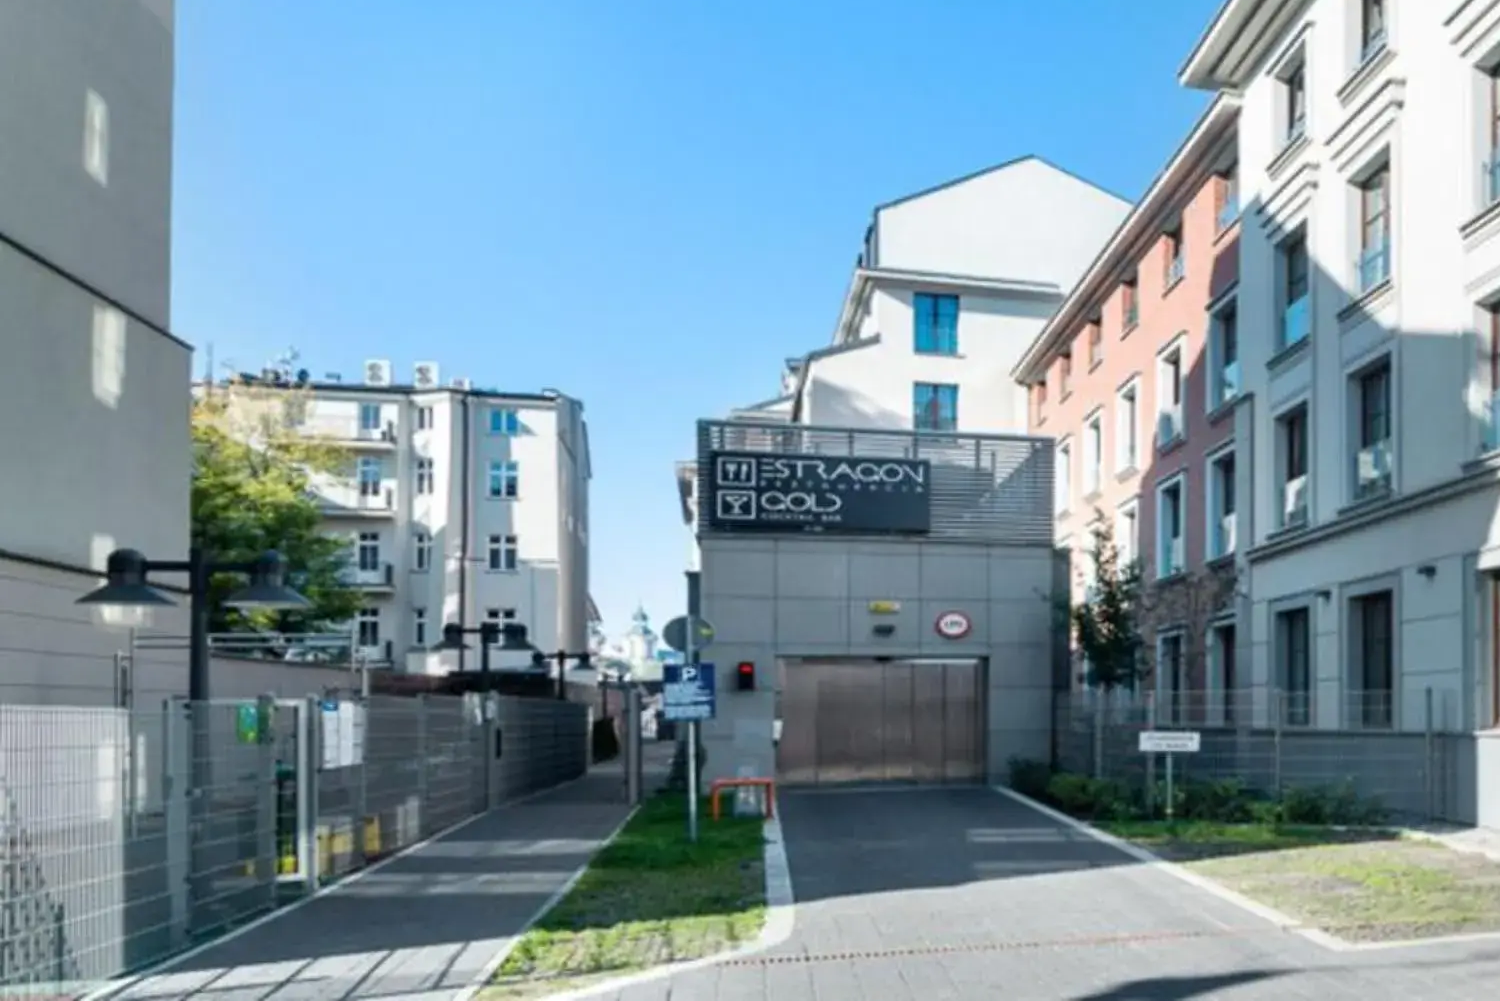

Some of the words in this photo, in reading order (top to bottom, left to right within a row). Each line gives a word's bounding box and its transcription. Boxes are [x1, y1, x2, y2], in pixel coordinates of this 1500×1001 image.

[760, 458, 924, 483] ESTRAGON
[760, 491, 842, 512] GOLD
[682, 666, 697, 681] P
